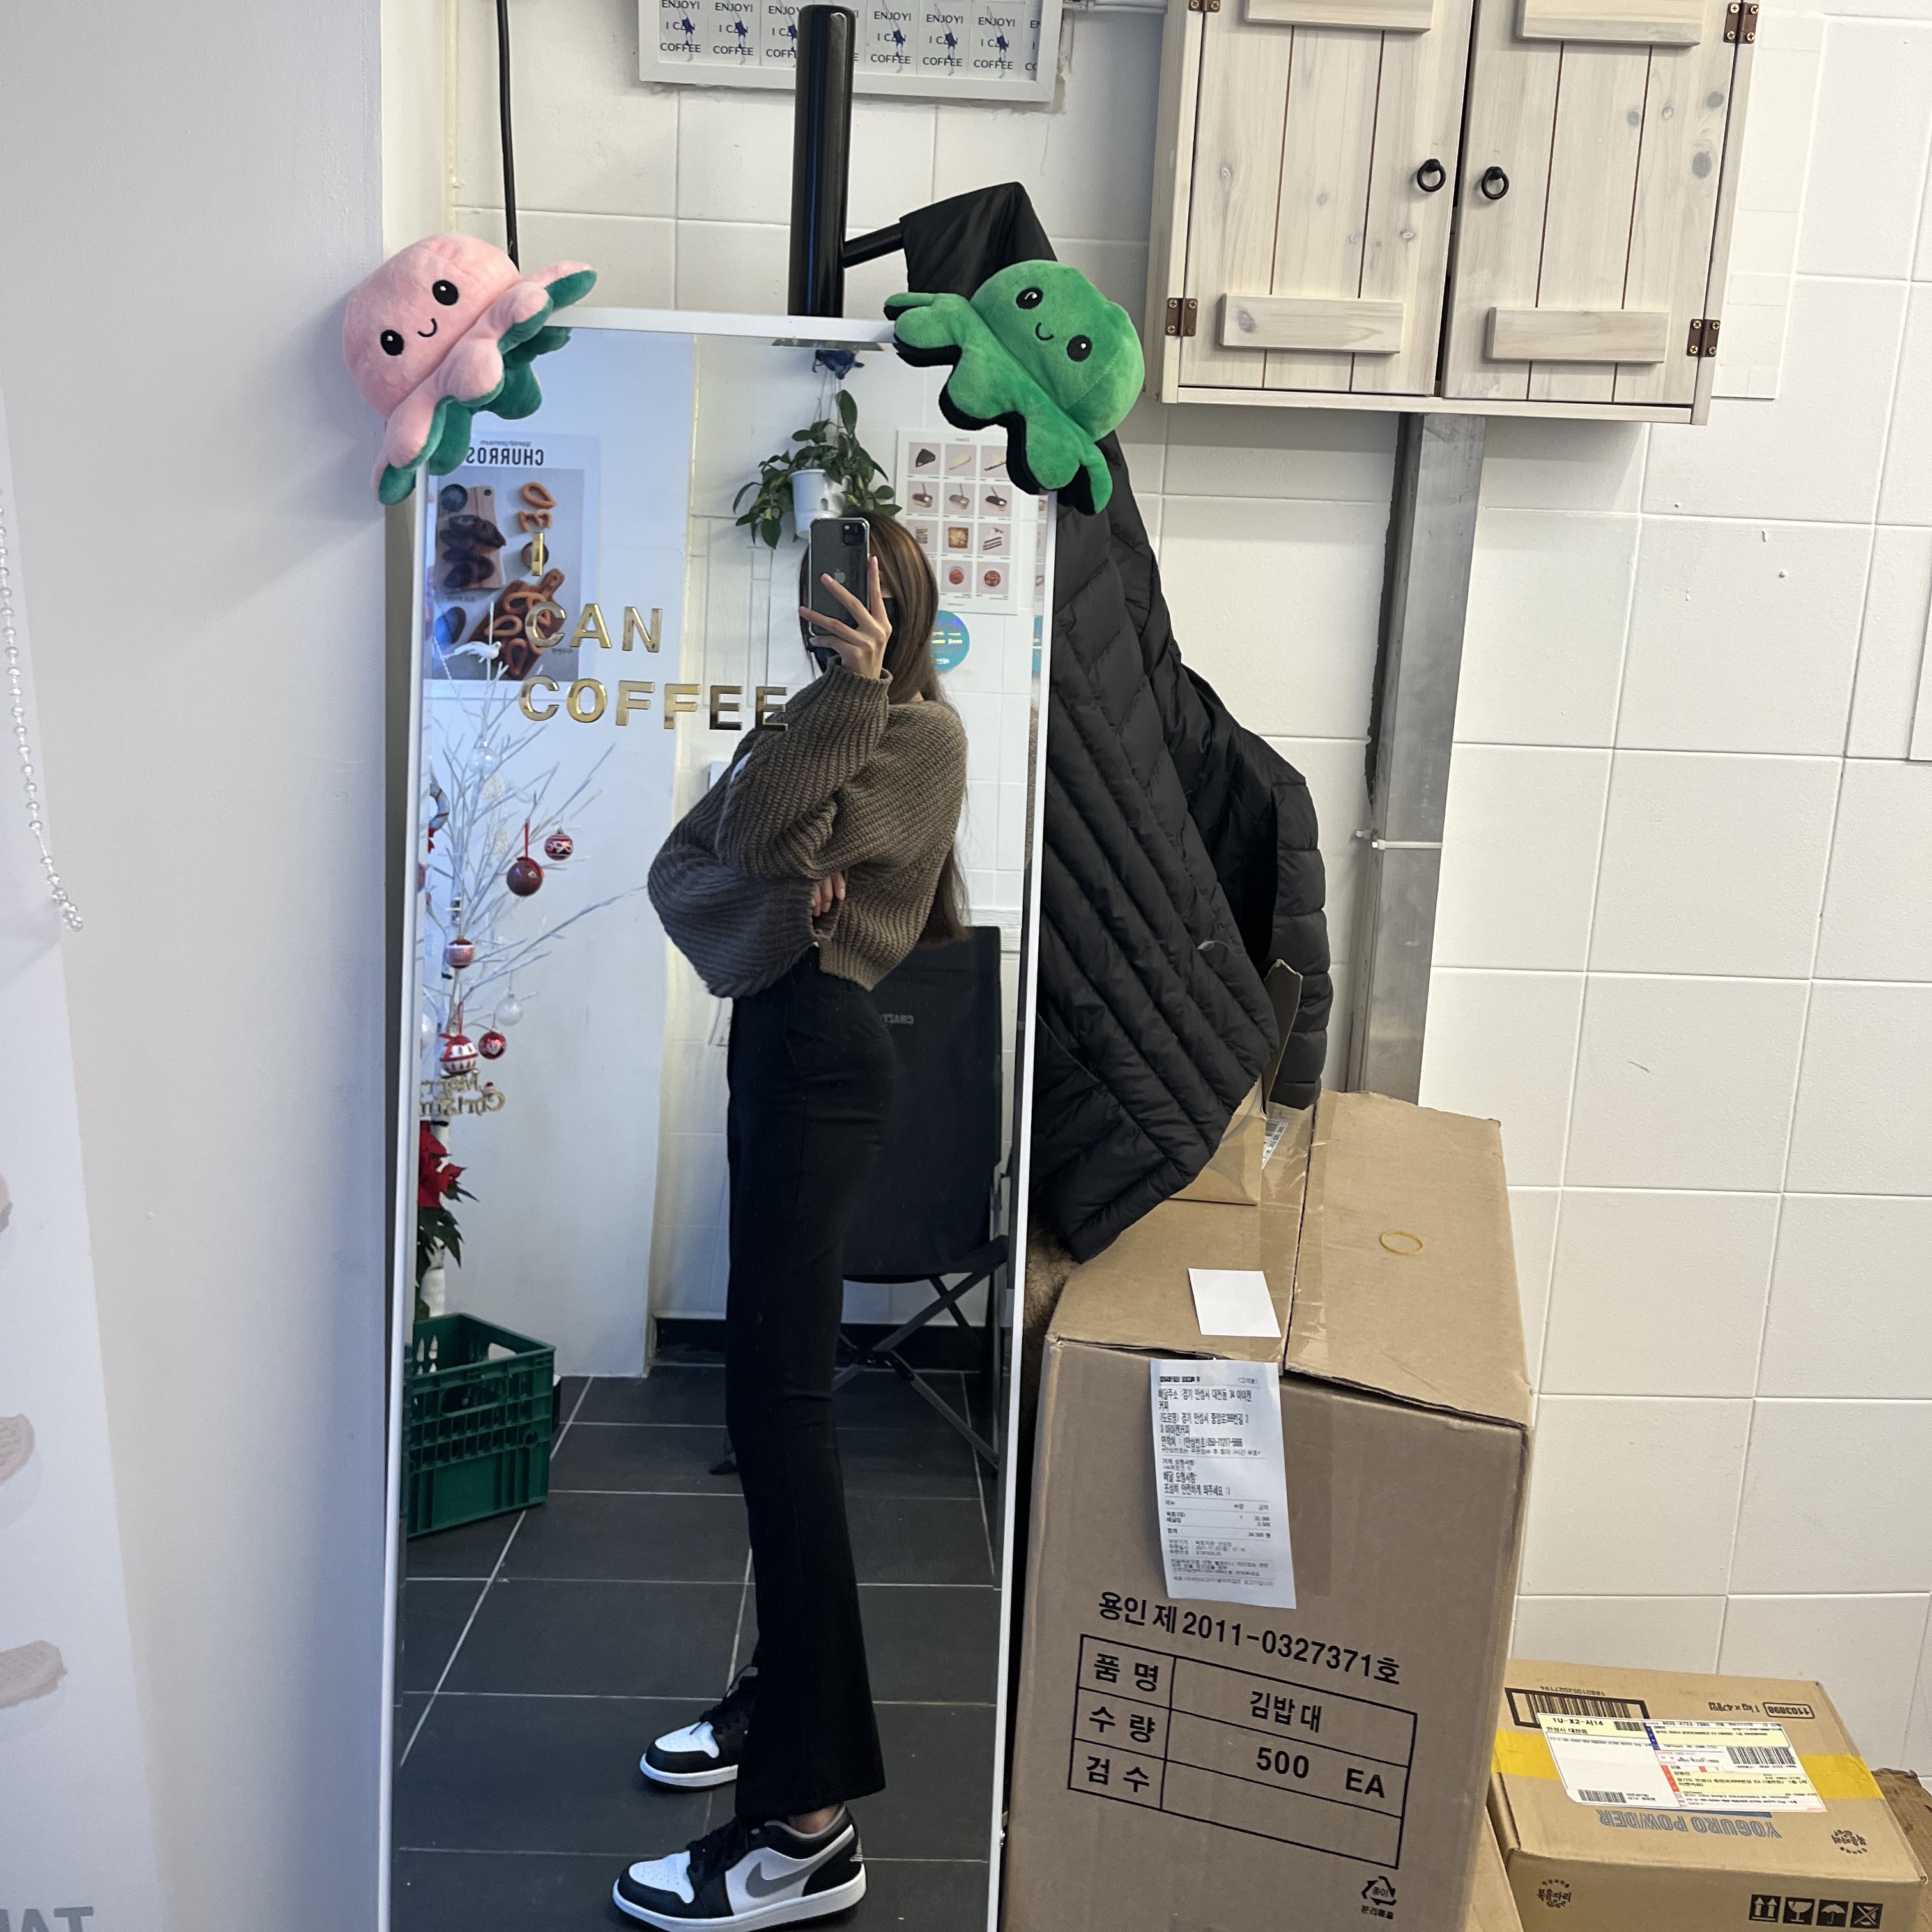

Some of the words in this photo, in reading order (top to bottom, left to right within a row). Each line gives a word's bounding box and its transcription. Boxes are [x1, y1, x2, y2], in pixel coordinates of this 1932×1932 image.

[660, 42, 702, 53] COFFEE
[713, 45, 754, 56] COFFEE
[871, 54, 911, 65] COFFEE
[923, 57, 963, 67] COFFEE
[974, 59, 1014, 70] COFFEE
[525, 601, 663, 653] CAN
[519, 675, 788, 732] COFFEE
[1255, 1746, 1310, 1779] 500
[1345, 1767, 1386, 1799] EA
[1596, 1809, 1689, 1832] POWDER
[1690, 1816, 1782, 1839] YOGURO
